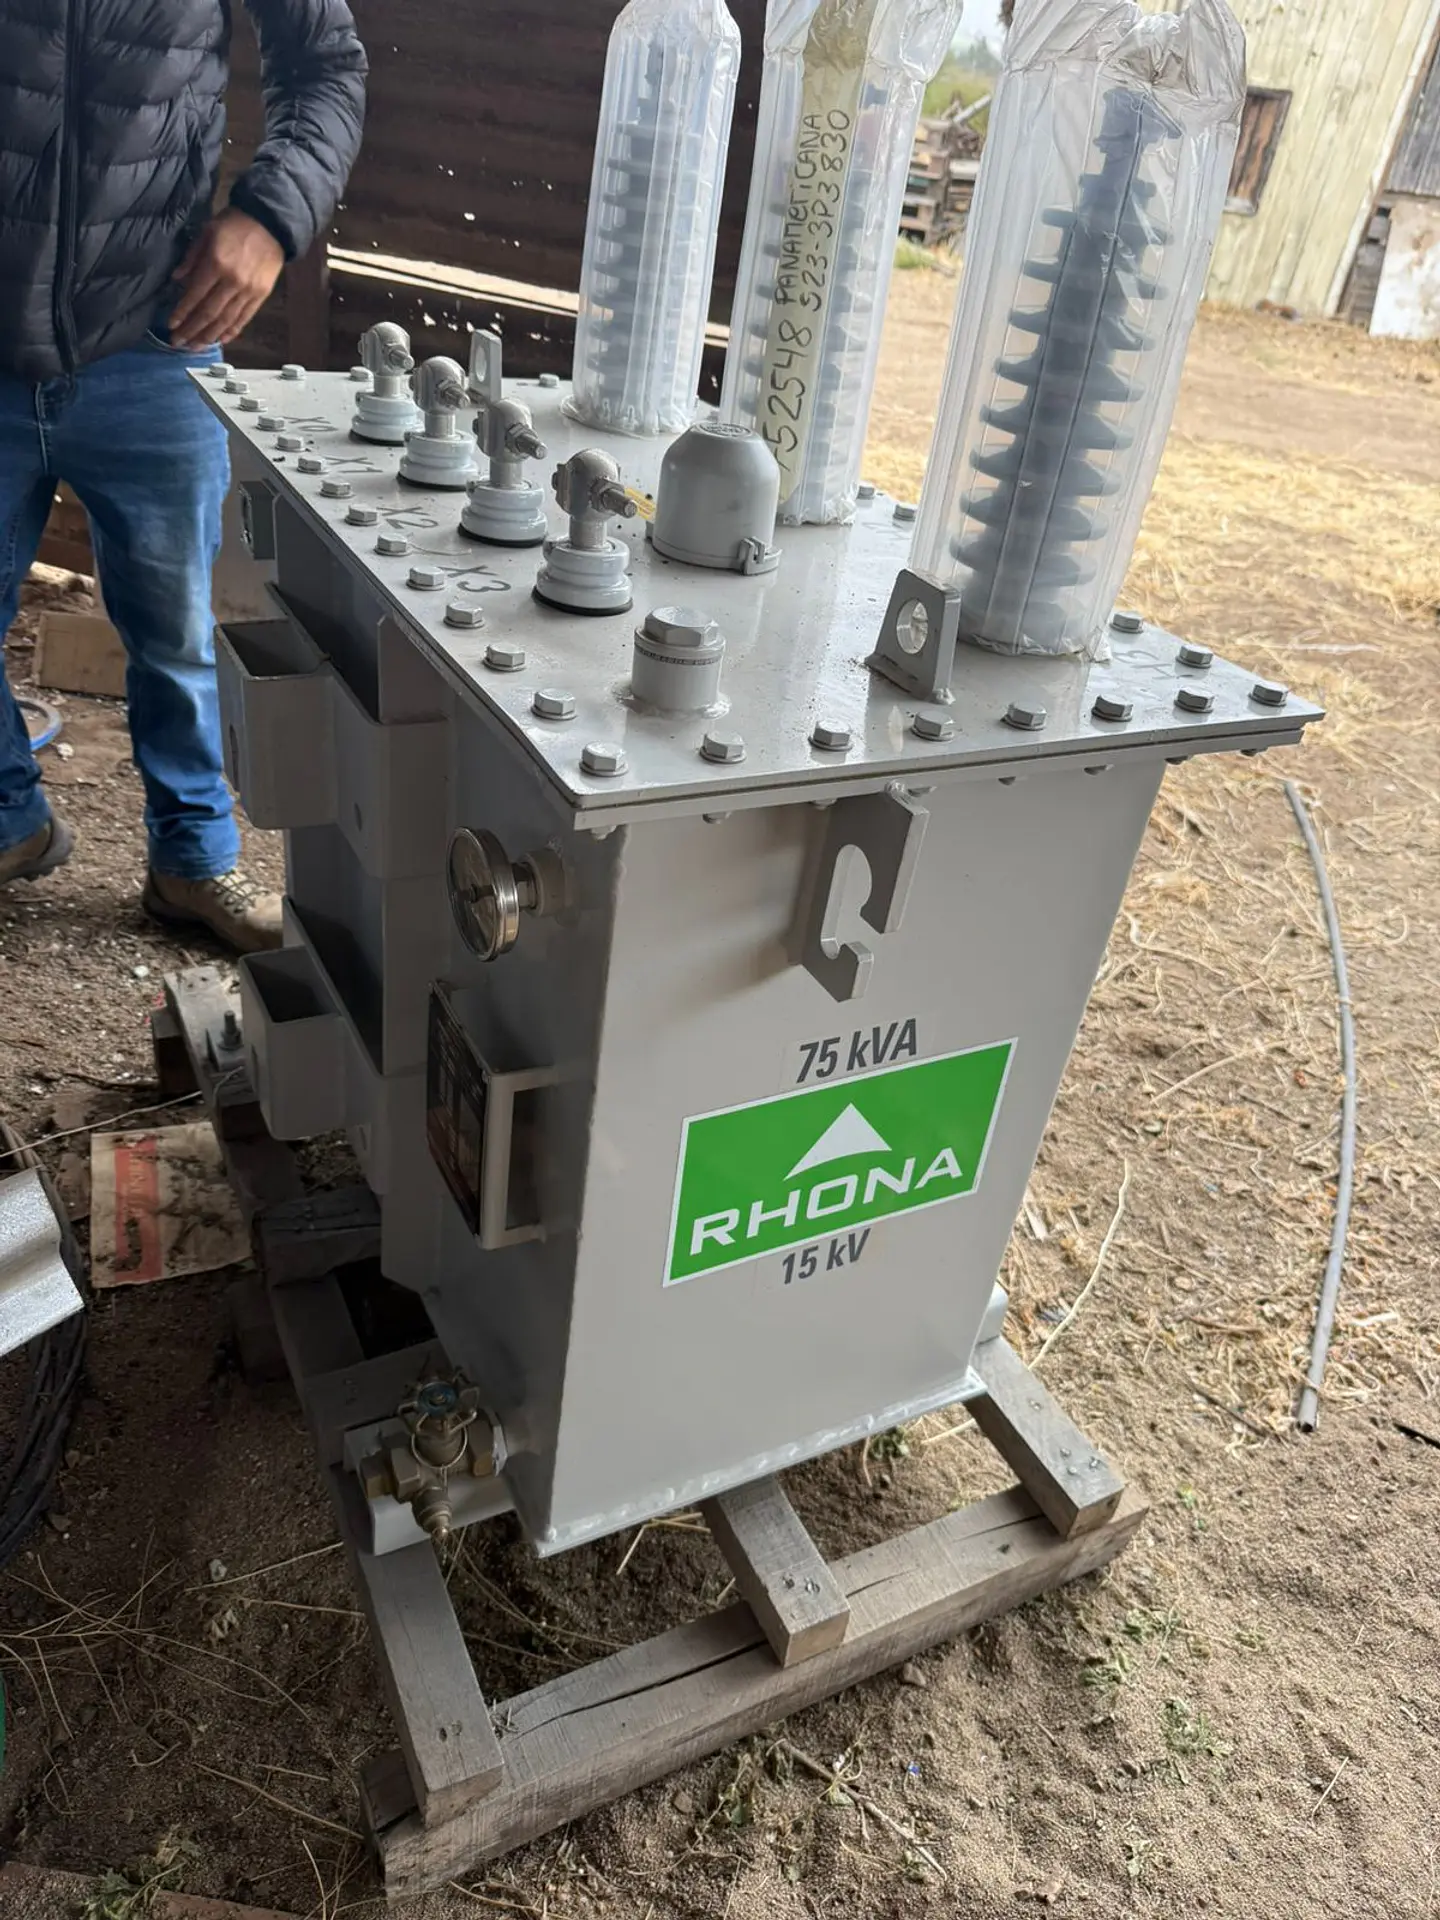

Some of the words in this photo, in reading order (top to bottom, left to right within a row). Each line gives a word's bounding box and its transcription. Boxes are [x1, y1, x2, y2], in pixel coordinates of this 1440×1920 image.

[820, 108, 850, 172] 830
[324, 456, 384, 474] X1
[376, 506, 440, 530] X2
[439, 565, 512, 593] X3
[796, 1036, 841, 1084] 75
[846, 1017, 917, 1072] kVA
[690, 1147, 963, 1256] RHONA
[782, 1245, 819, 1285] 15
[826, 1228, 872, 1271] kV
